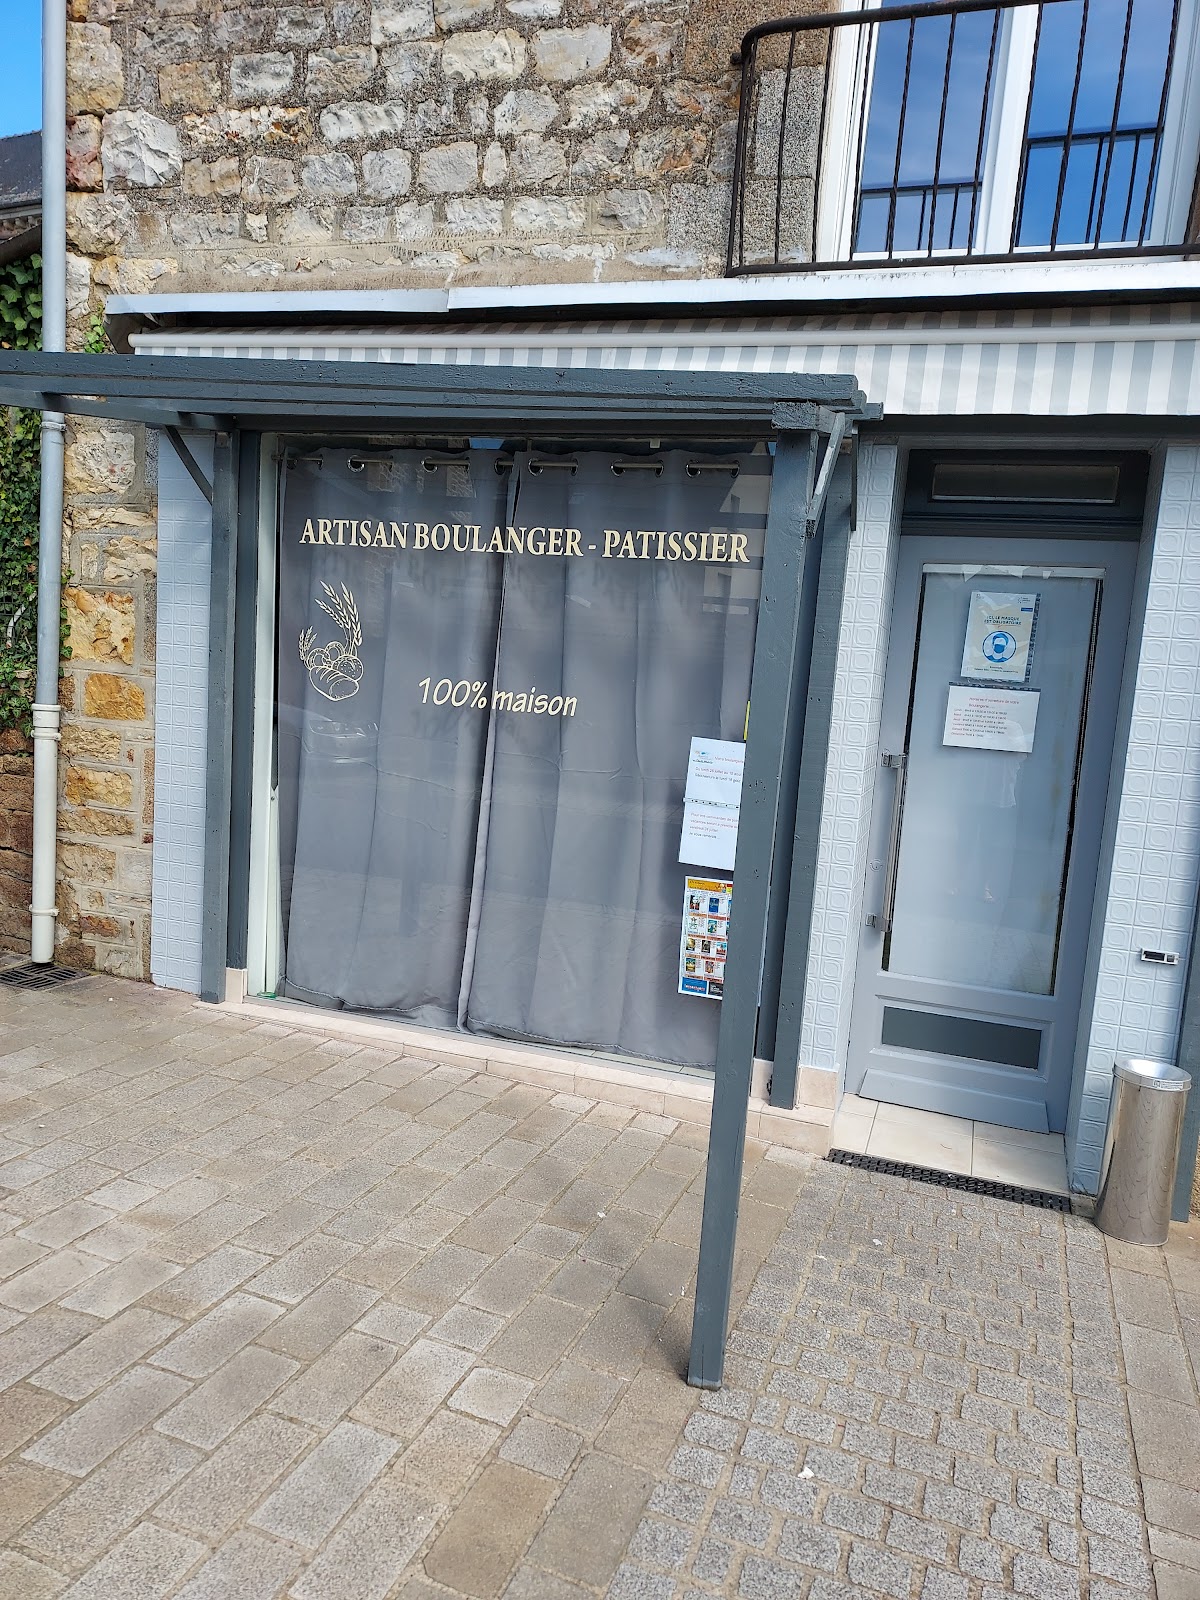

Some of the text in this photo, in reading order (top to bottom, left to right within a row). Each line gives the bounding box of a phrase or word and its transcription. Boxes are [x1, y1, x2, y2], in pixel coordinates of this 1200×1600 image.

[299, 518, 409, 549] ARTISAN
[413, 522, 583, 557] BOULANGER
[601, 530, 750, 563] PATISSIER
[418, 677, 578, 717] 100% maison
